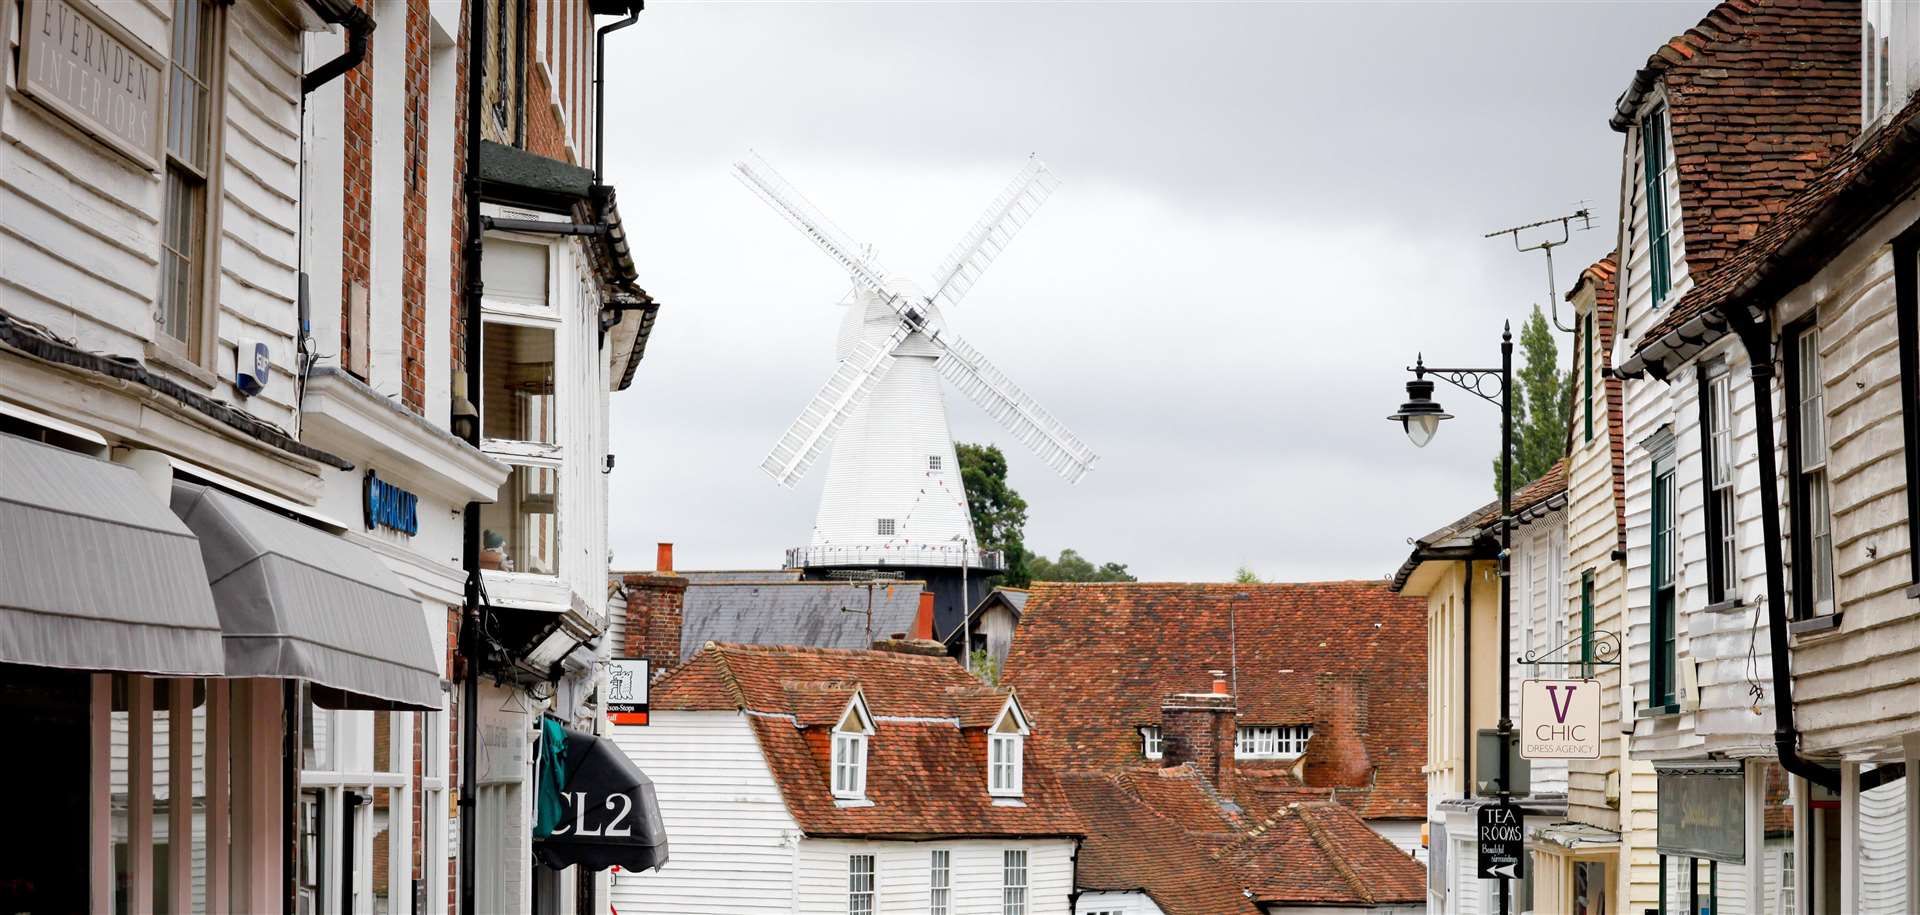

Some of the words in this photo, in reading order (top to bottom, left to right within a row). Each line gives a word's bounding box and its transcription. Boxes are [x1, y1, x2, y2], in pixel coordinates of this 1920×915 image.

[42, 0, 149, 104] EVERNDEN
[38, 41, 148, 147] INTERIORS
[379, 479, 418, 537] BARCLAYS
[1545, 685, 1577, 724] V
[1535, 724, 1586, 742] CHIC
[1527, 744, 1554, 753] DRESS
[1555, 744, 1594, 753] AGENCY
[1484, 808, 1517, 824] TEA
[1481, 825, 1522, 841] ROOMS
